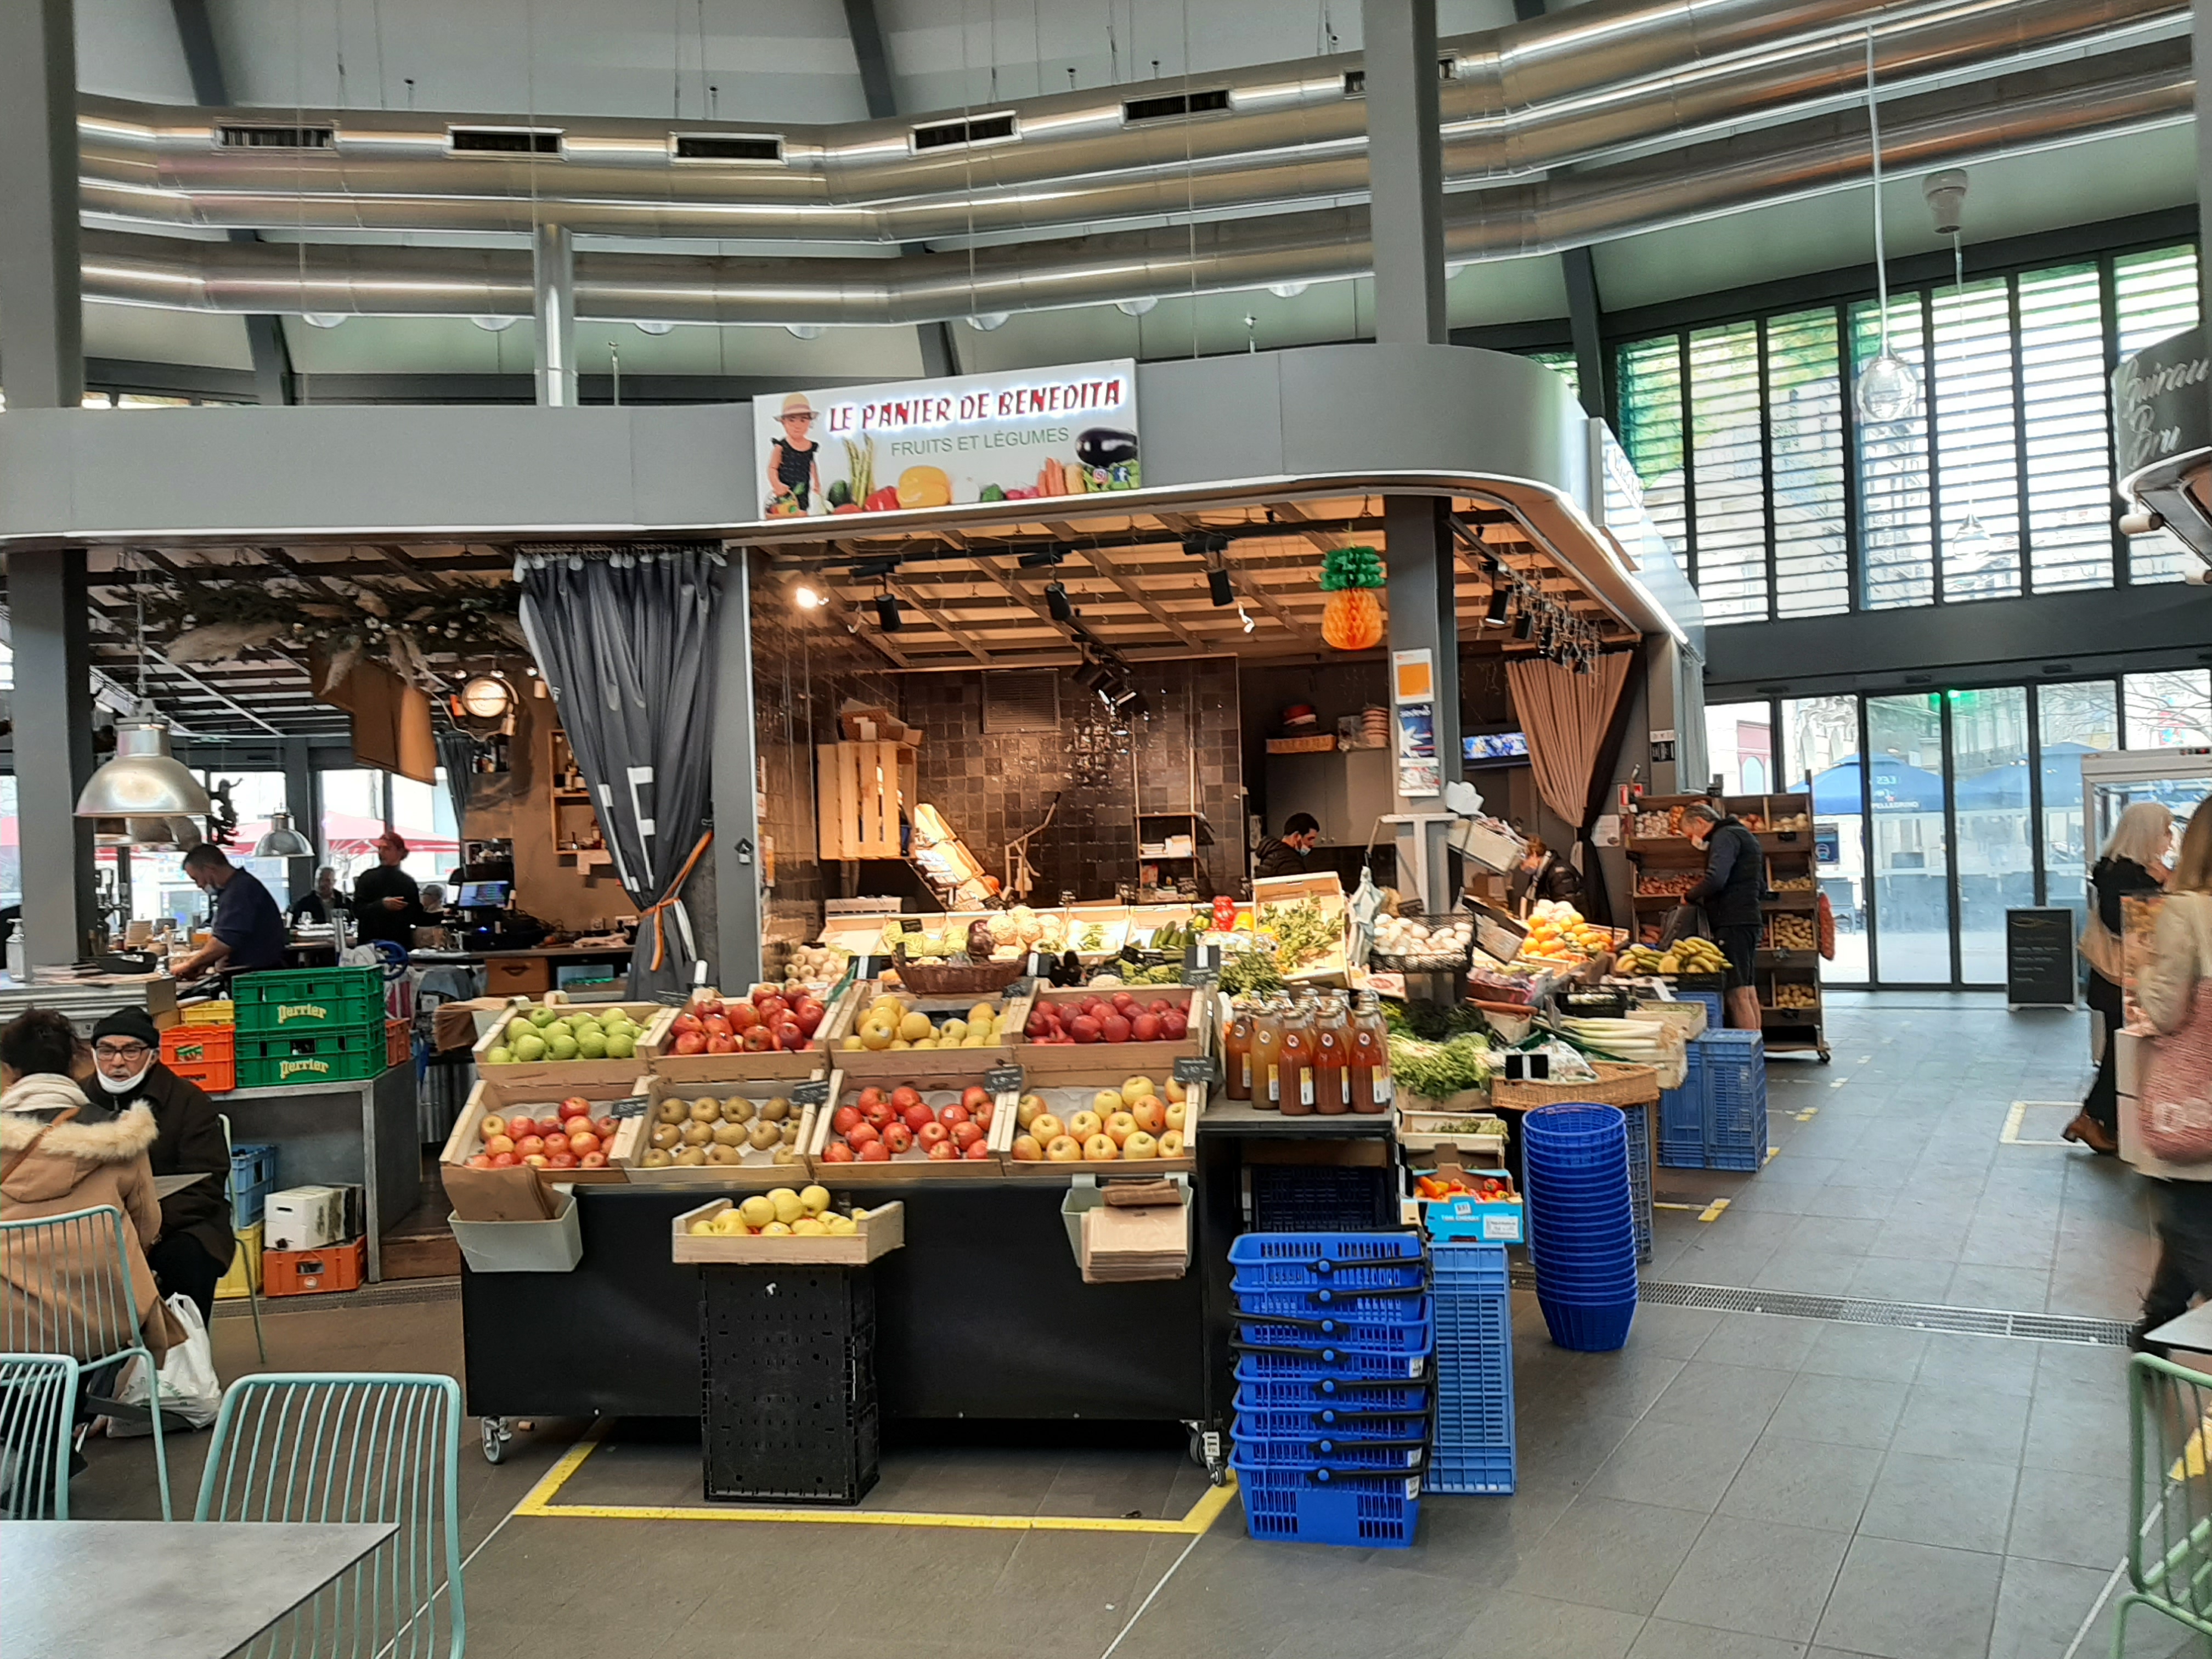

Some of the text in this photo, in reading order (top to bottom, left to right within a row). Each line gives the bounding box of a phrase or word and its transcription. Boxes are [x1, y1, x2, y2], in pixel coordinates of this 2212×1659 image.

[830, 379, 1120, 432] LE PANIER DE BENEDITA
[891, 427, 1069, 456] FRUITS ET LÉGUMES
